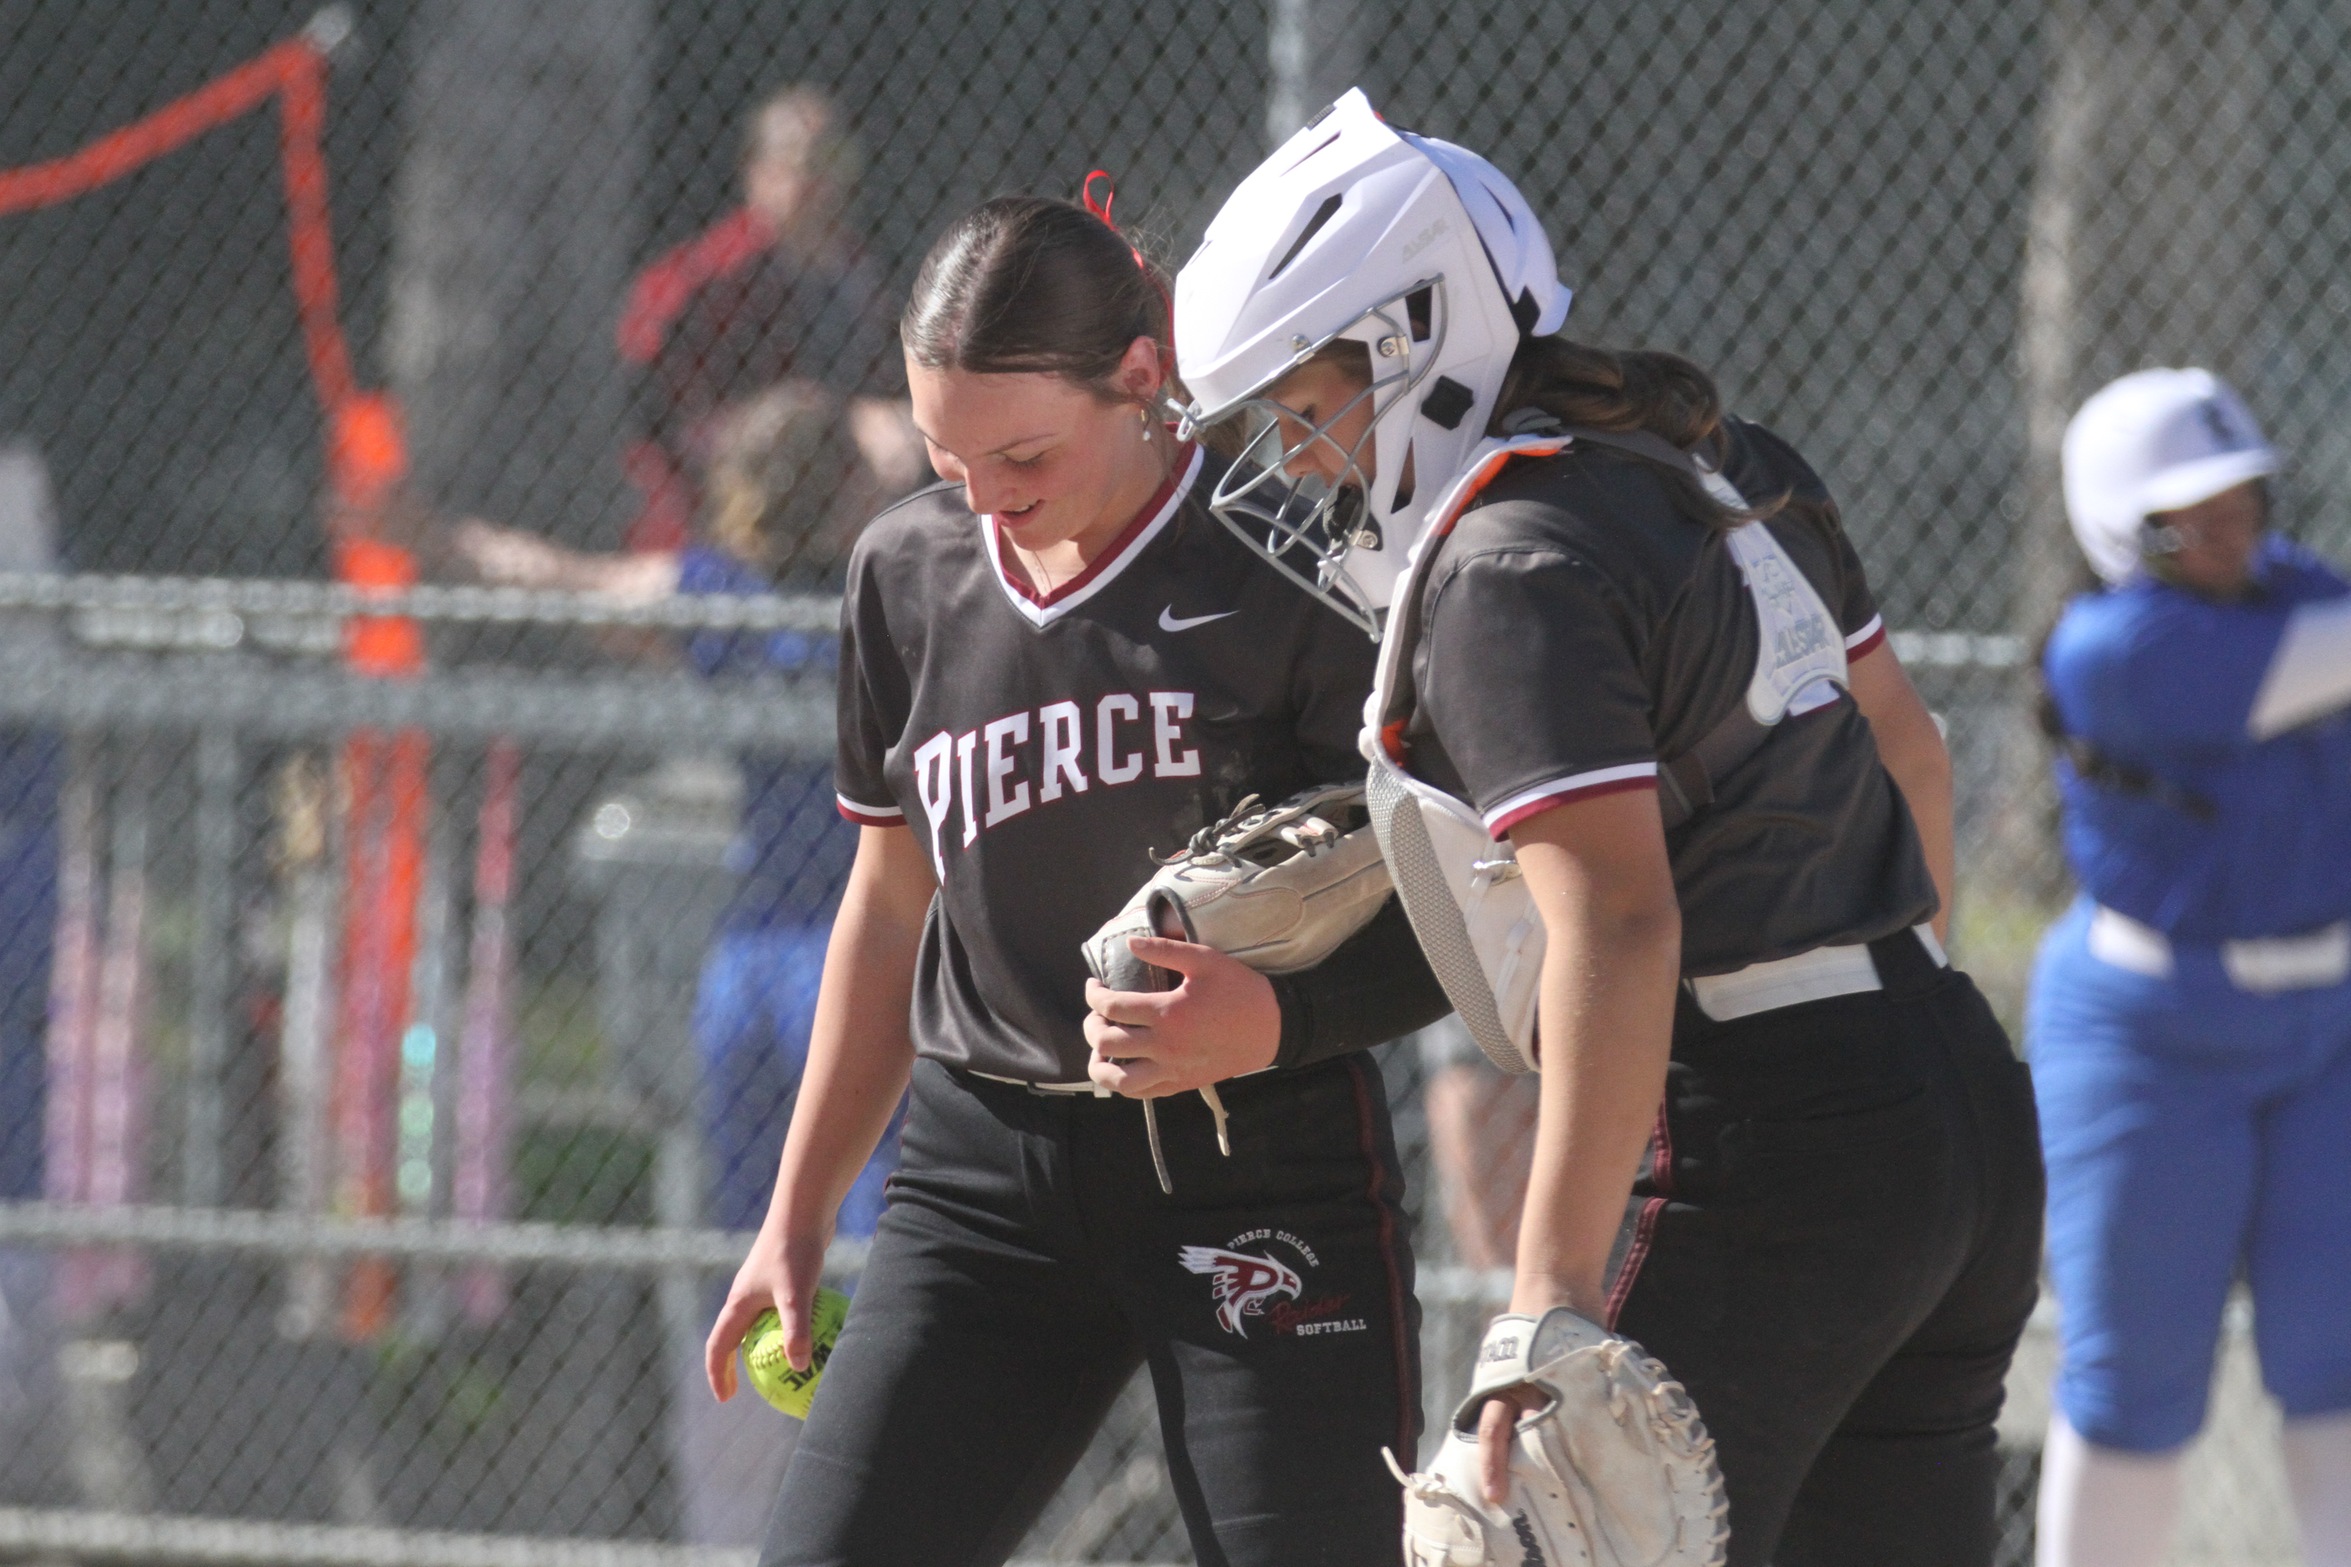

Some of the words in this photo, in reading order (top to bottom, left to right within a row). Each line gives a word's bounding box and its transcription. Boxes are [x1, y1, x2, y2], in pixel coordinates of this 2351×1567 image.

[912, 690, 1202, 888] PIERCE
[1227, 1228, 1272, 1250] PIERCE
[1275, 1230, 1320, 1268] COLLEGE
[1296, 1318, 1367, 1336] SOFTBALL
